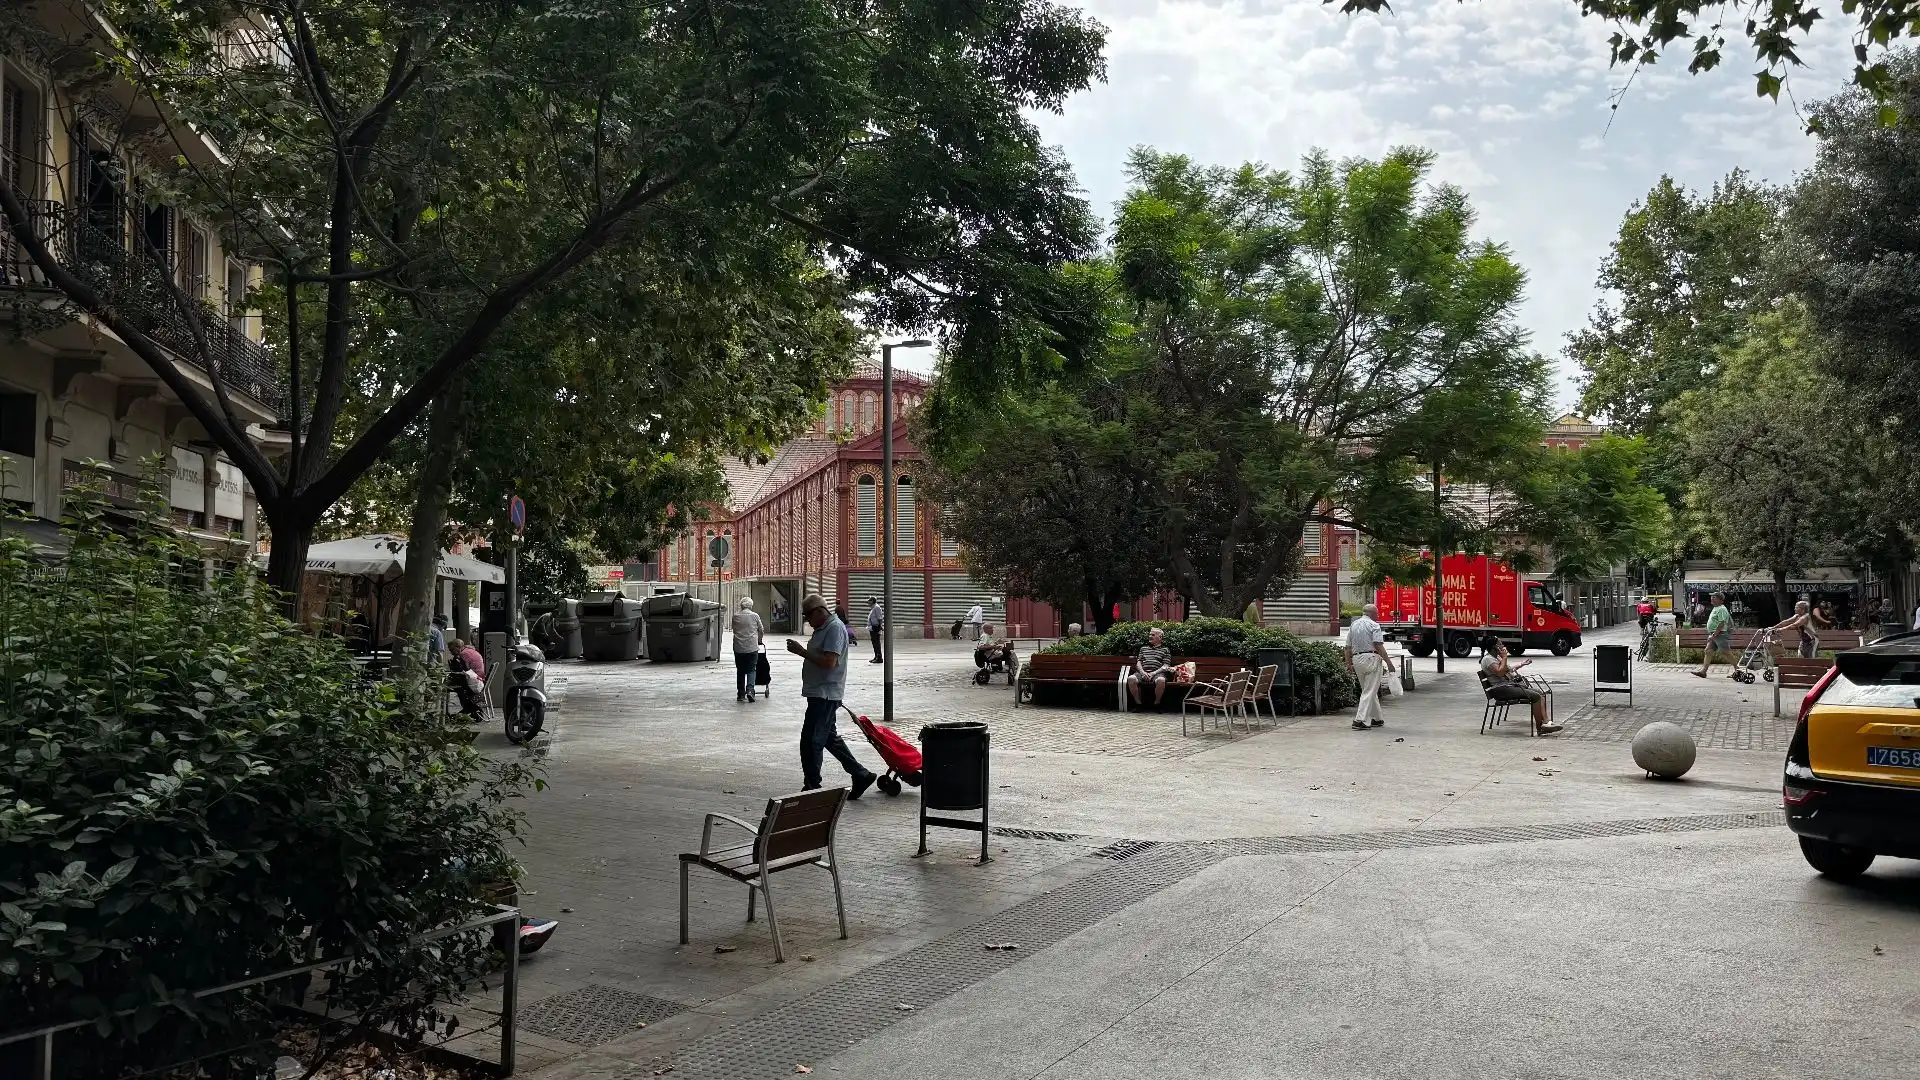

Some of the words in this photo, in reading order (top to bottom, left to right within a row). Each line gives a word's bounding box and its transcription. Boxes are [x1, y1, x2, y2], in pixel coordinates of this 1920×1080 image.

[1425, 574, 1467, 590] MMMA
[1469, 572, 1476, 590] È
[1878, 749, 1920, 766] 7658
